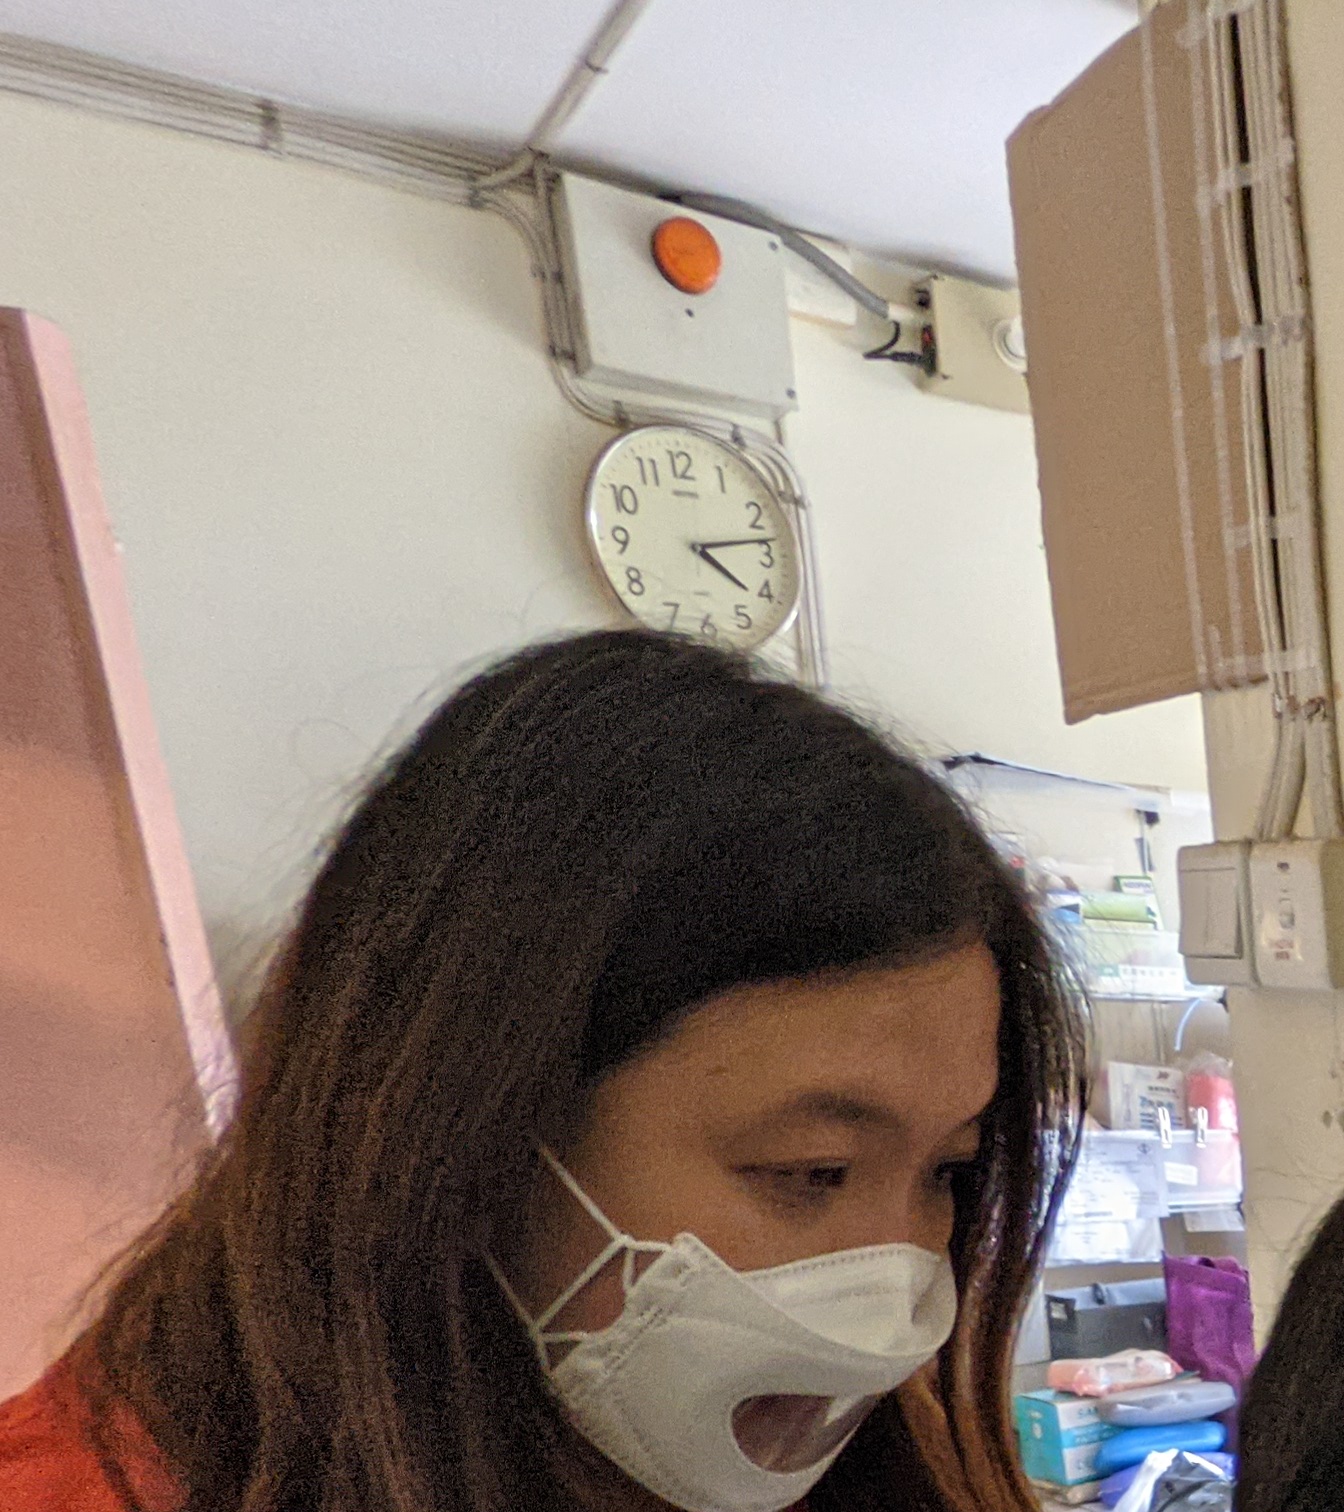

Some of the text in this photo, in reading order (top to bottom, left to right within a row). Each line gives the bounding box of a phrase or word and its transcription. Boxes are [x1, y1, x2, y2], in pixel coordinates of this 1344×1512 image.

[636, 457, 660, 487] 11
[666, 449, 696, 481] 12
[716, 465, 727, 494] 1
[610, 483, 638, 515] 10
[745, 501, 766, 530] 2
[611, 526, 630, 555] 9
[757, 540, 775, 569] 3
[625, 566, 645, 596] 8
[757, 579, 776, 604] 4
[662, 602, 680, 633] 7
[700, 613, 718, 640] 6
[733, 604, 753, 630] 5
